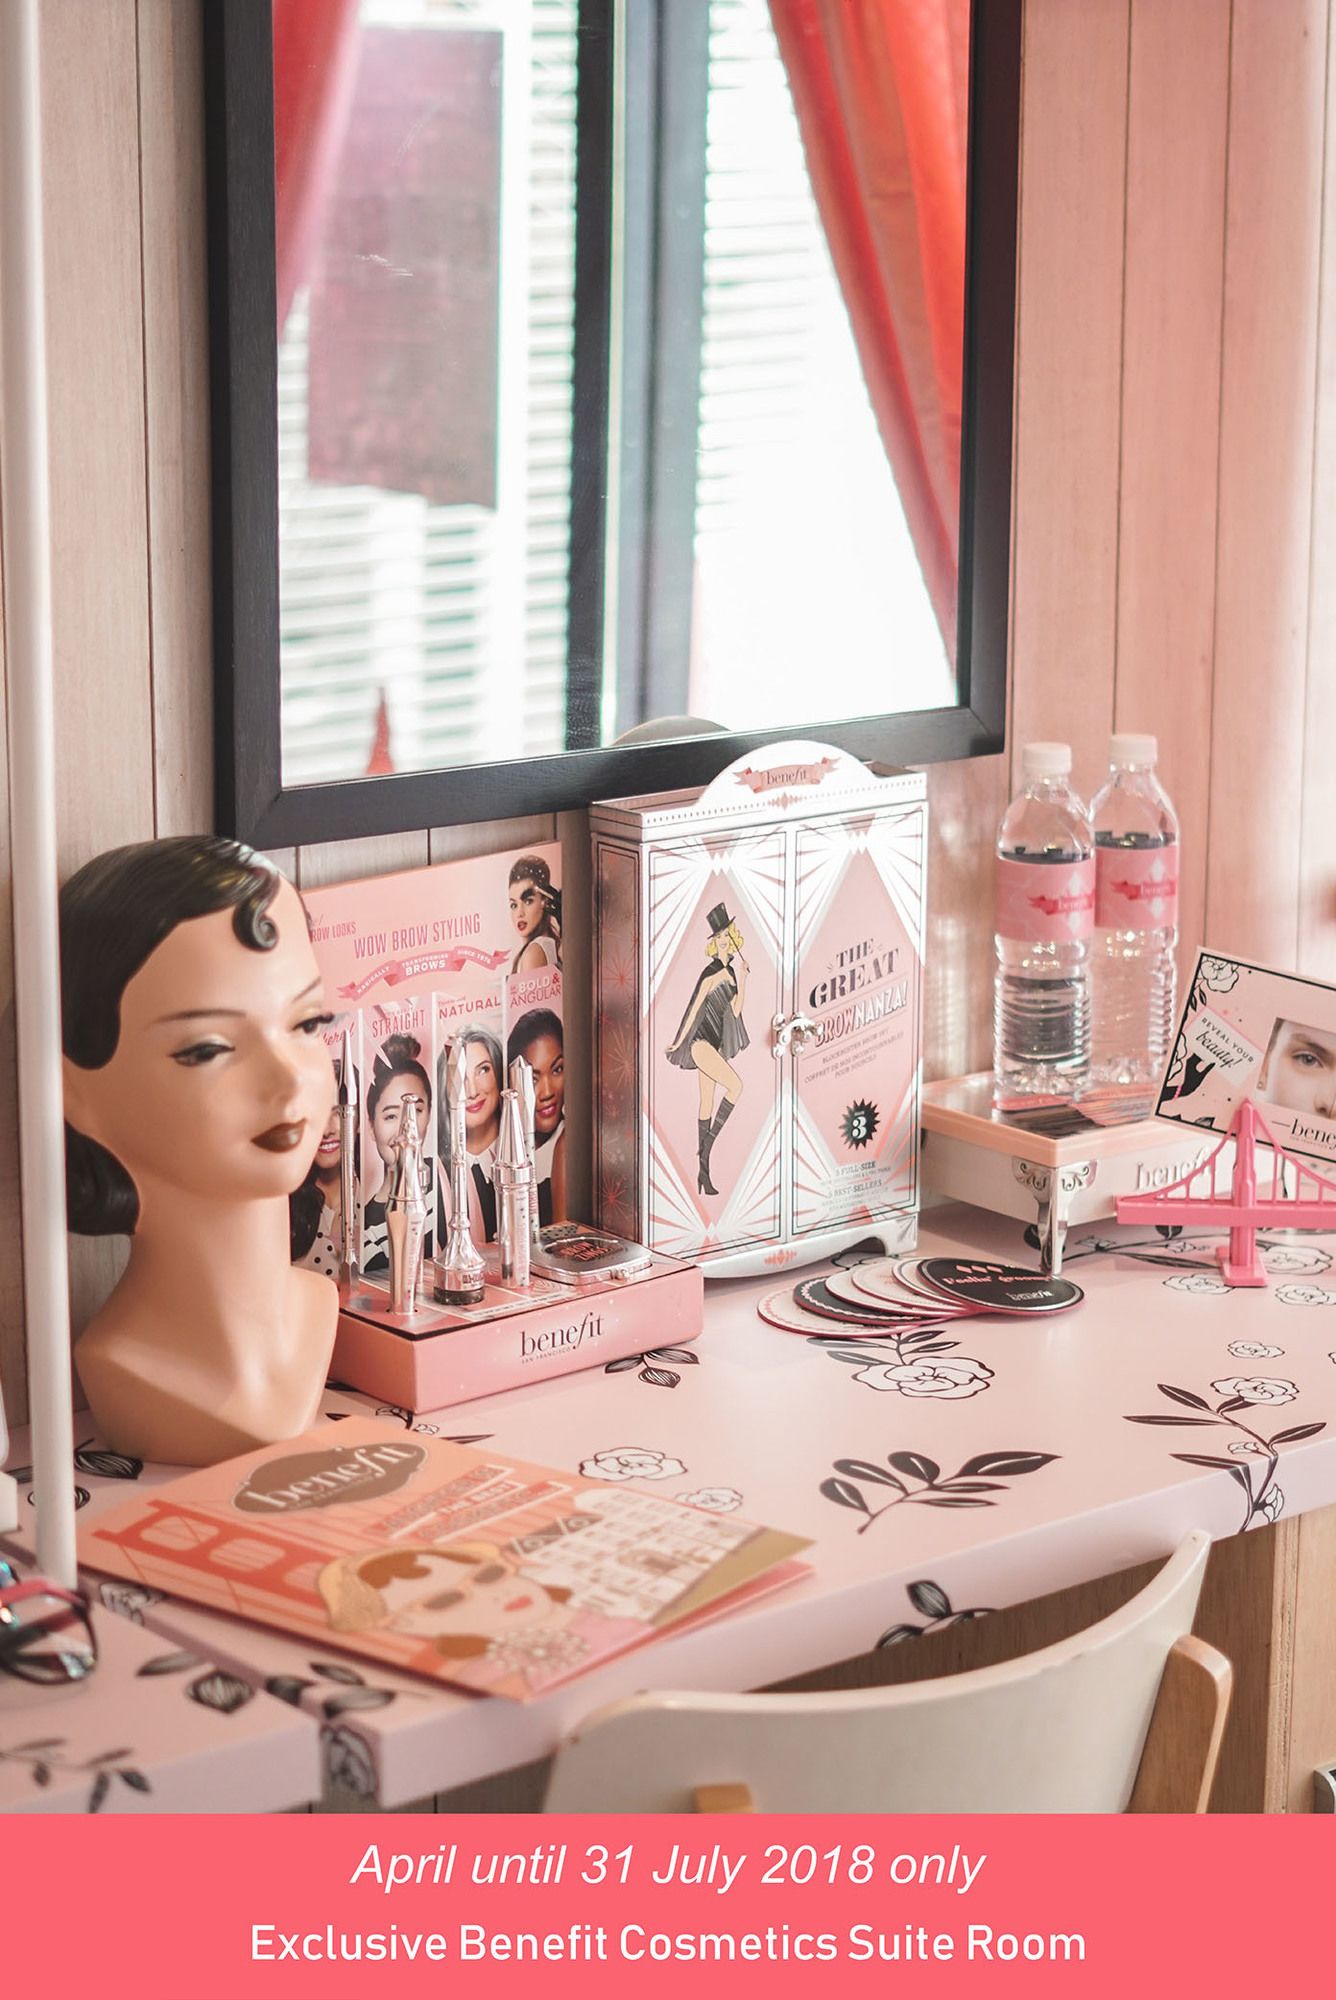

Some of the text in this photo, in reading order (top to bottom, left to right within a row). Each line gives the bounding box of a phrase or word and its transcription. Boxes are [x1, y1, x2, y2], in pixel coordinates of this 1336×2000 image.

[766, 768, 807, 786] benefit
[332, 921, 357, 939] LOOKS
[353, 913, 481, 959] WOW BROW STYLING
[836, 938, 874, 967] THE
[405, 959, 447, 976] BROWS
[809, 948, 899, 1008] GREAT
[510, 985, 562, 1009] ANGULAR
[518, 976, 550, 994] BOLD
[551, 972, 560, 985] &
[439, 997, 501, 1019] NATURAL
[815, 980, 908, 1048] BROWNANZA!
[372, 1010, 426, 1038] STRAIGHT
[1195, 1031, 1243, 1069] beauty!
[1201, 1017, 1255, 1063] REVEAL YOUR
[852, 1116, 867, 1139] 3
[520, 1312, 605, 1356] benefit
[246, 1446, 416, 1508] benefit
